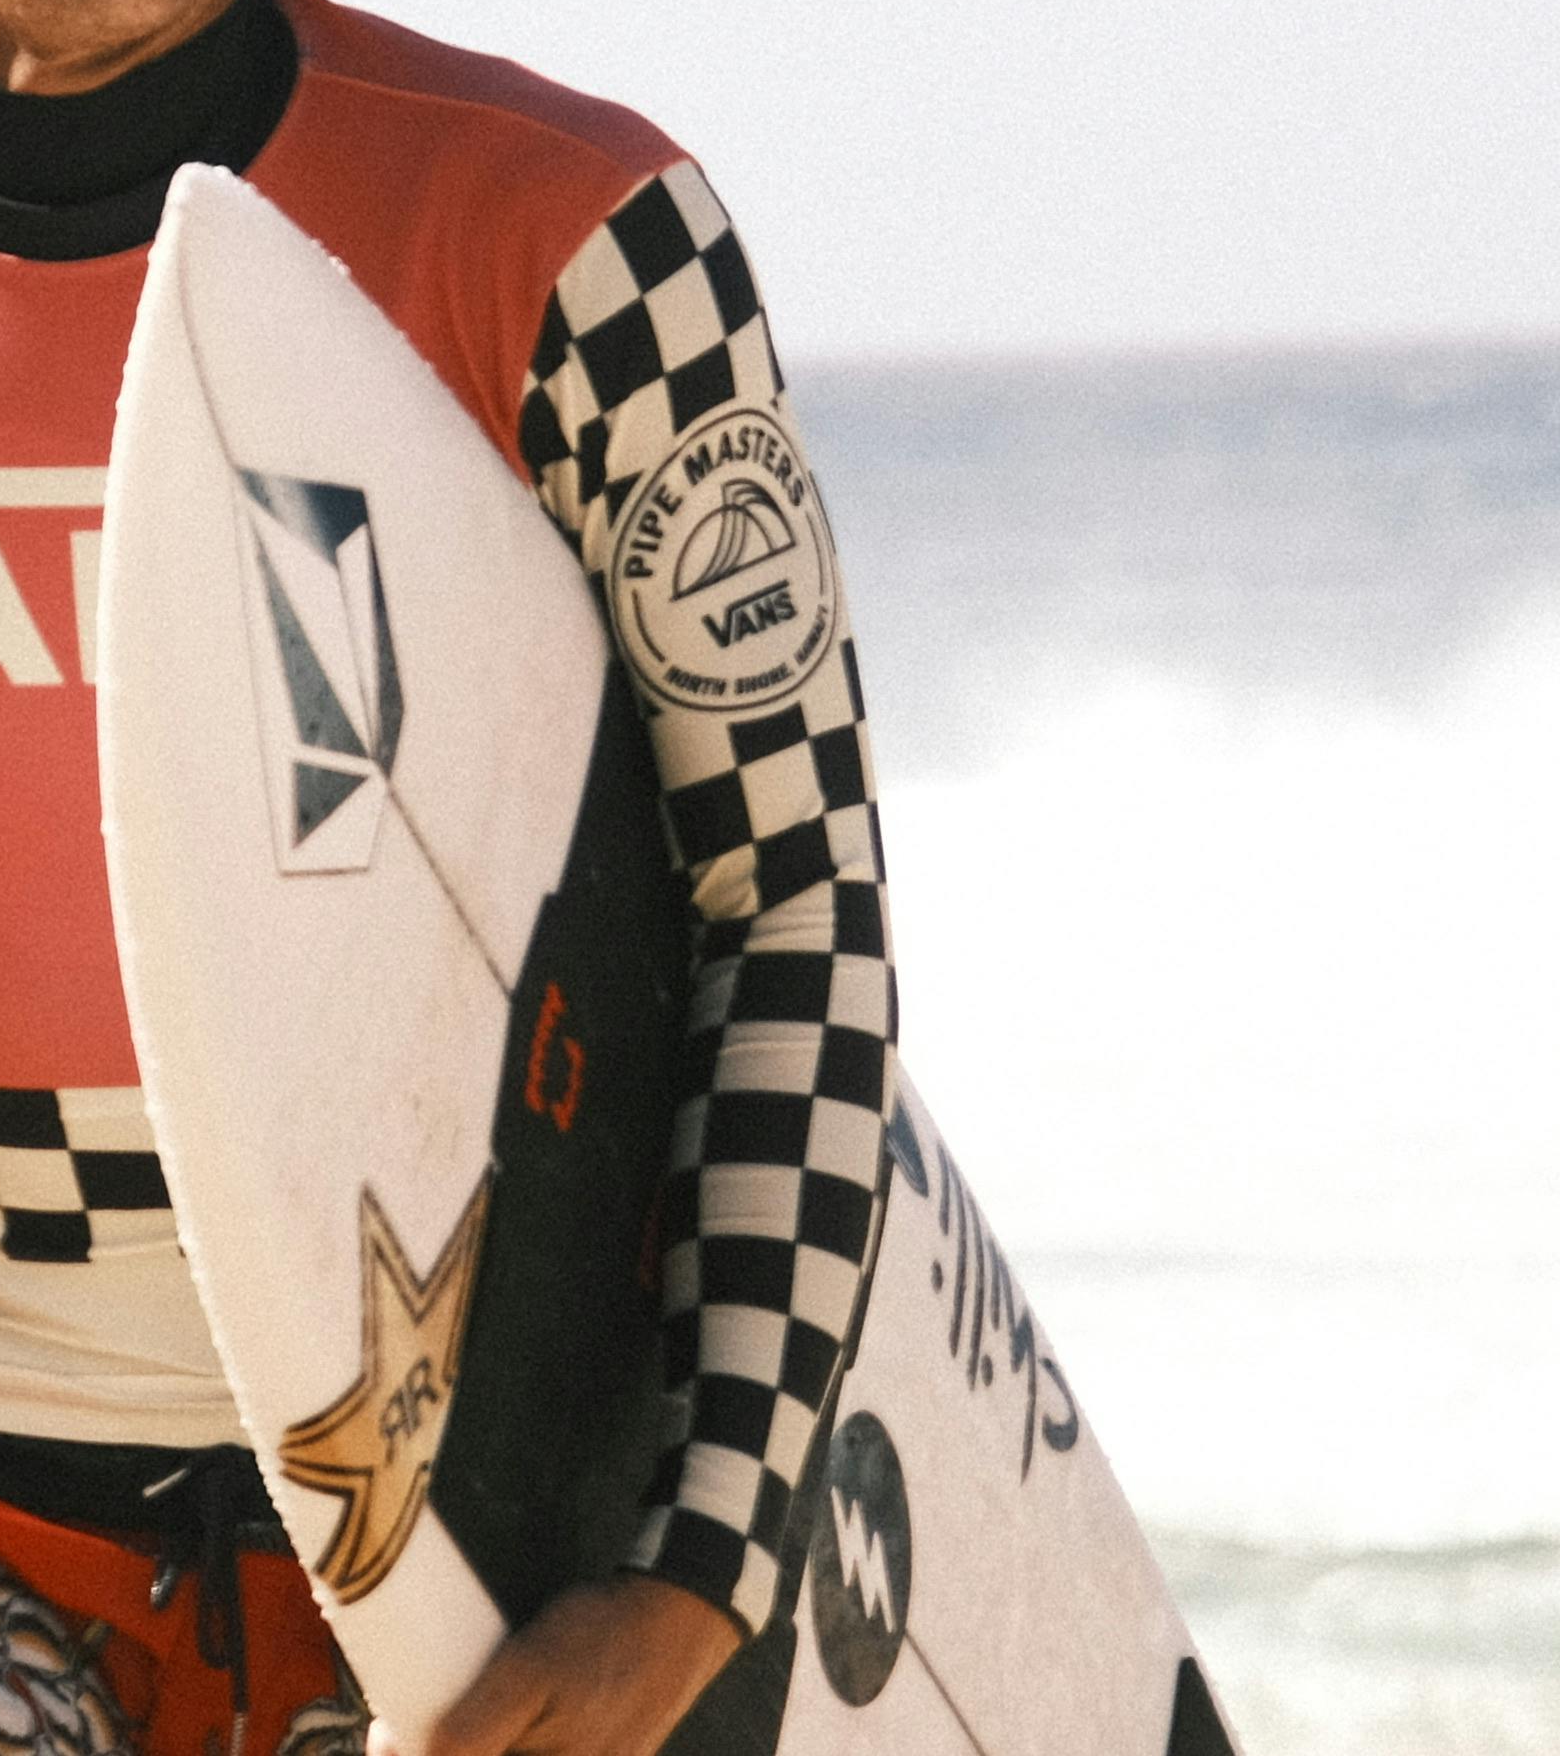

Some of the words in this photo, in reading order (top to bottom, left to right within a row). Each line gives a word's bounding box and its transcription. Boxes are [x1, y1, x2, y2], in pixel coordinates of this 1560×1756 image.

[625, 484, 683, 578] PIPE
[684, 426, 804, 507] MASTERS
[701, 579, 797, 648] VANS
[665, 666, 727, 696] NORTH
